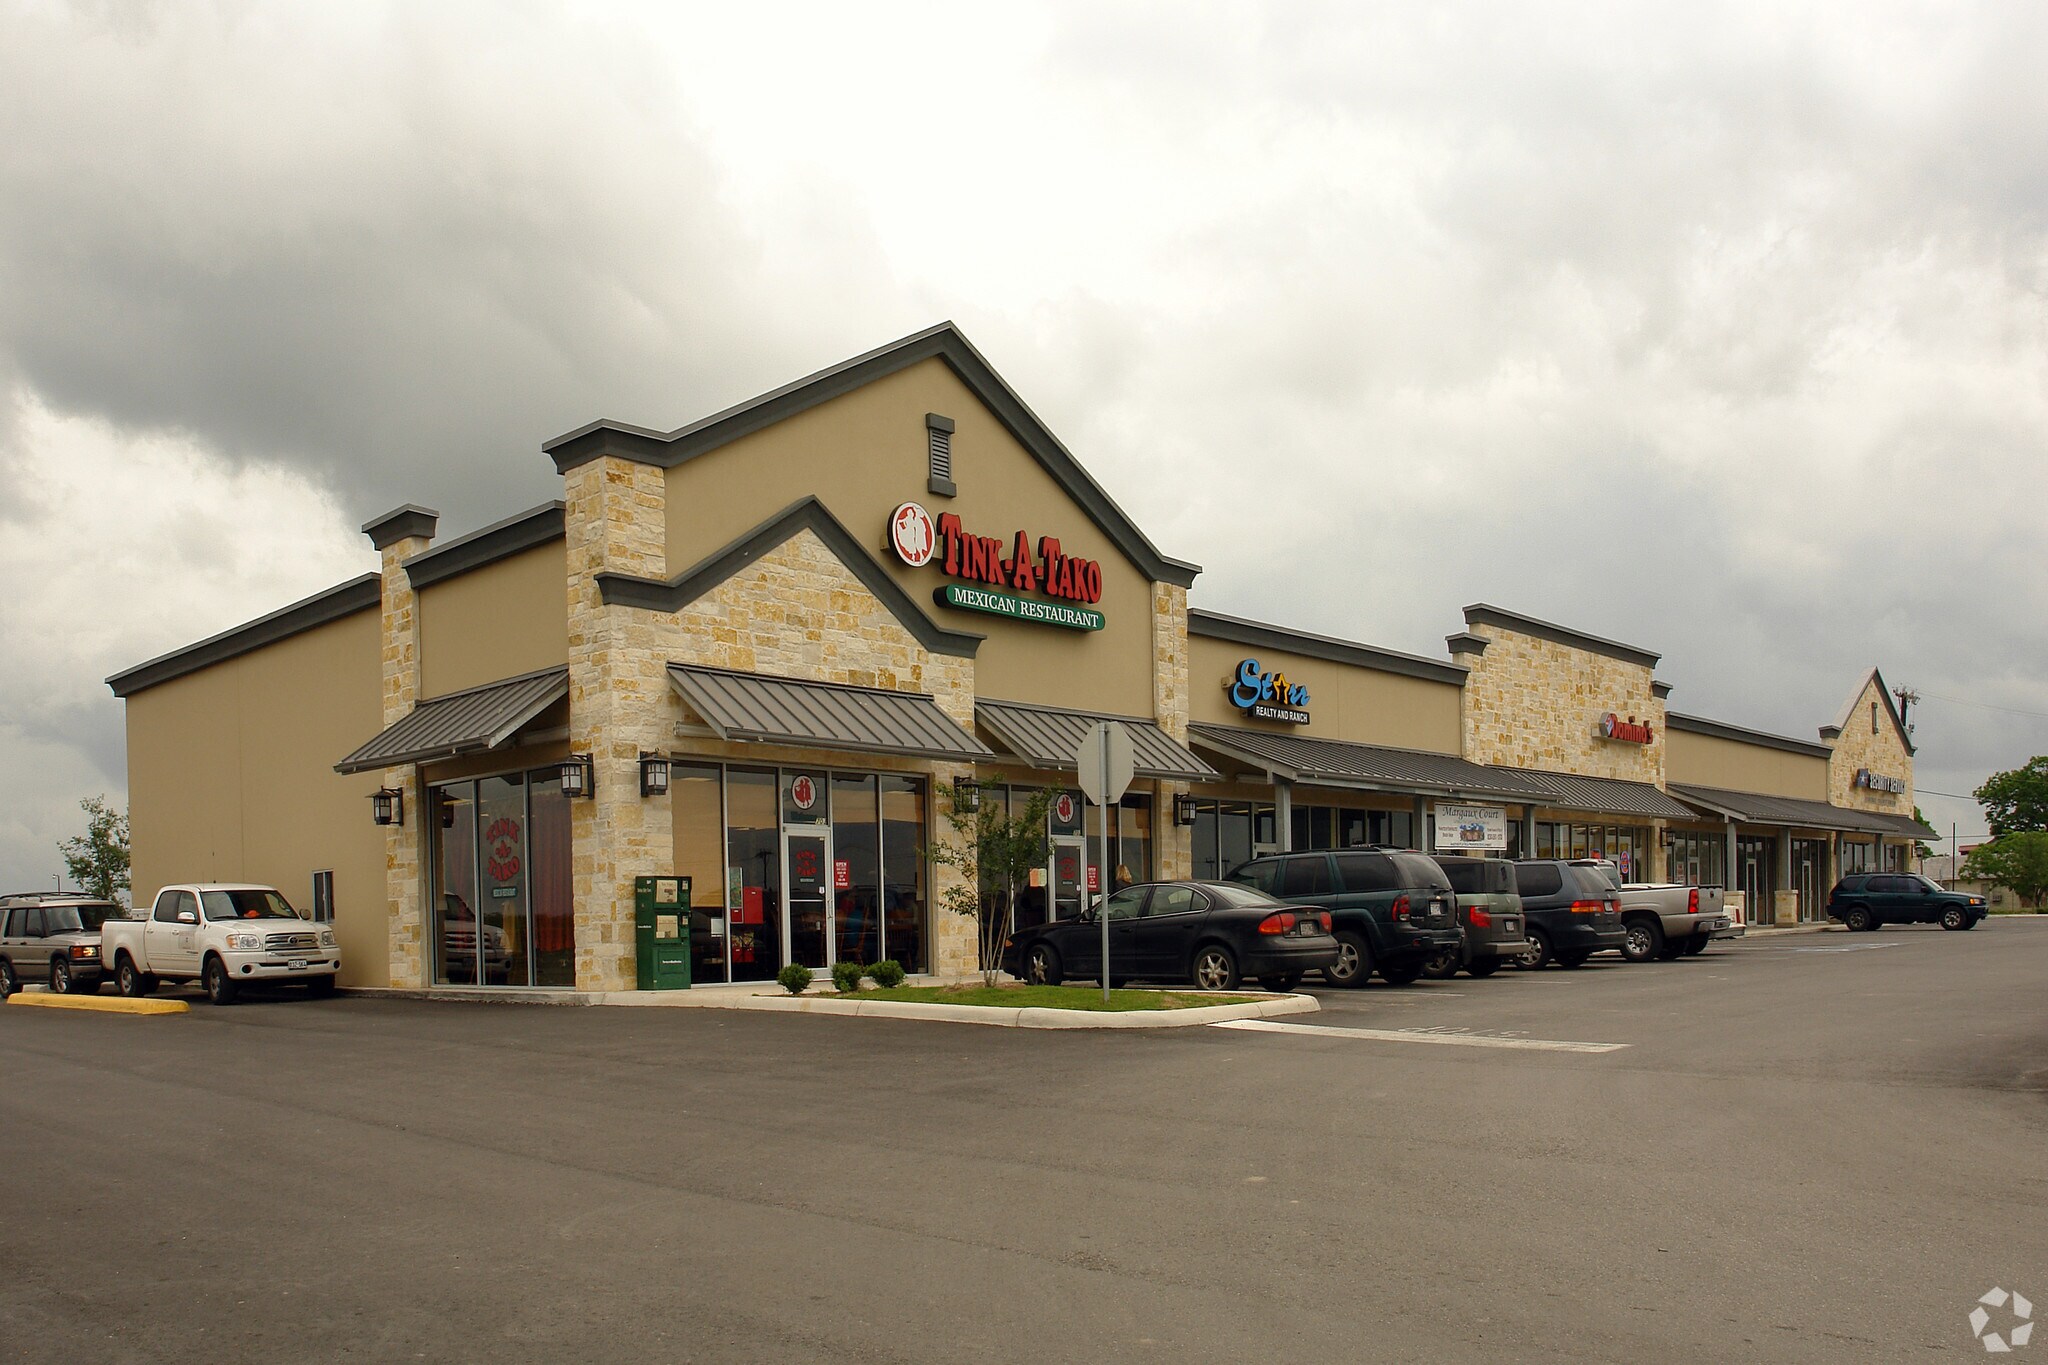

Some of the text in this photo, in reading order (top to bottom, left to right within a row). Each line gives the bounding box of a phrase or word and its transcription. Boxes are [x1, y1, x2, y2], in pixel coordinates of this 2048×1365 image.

[953, 587, 1099, 628] MEXICAN RESTAURANT
[1255, 705, 1308, 723] REALTY AND RANCH
[1442, 806, 1499, 820] Margaux Court
